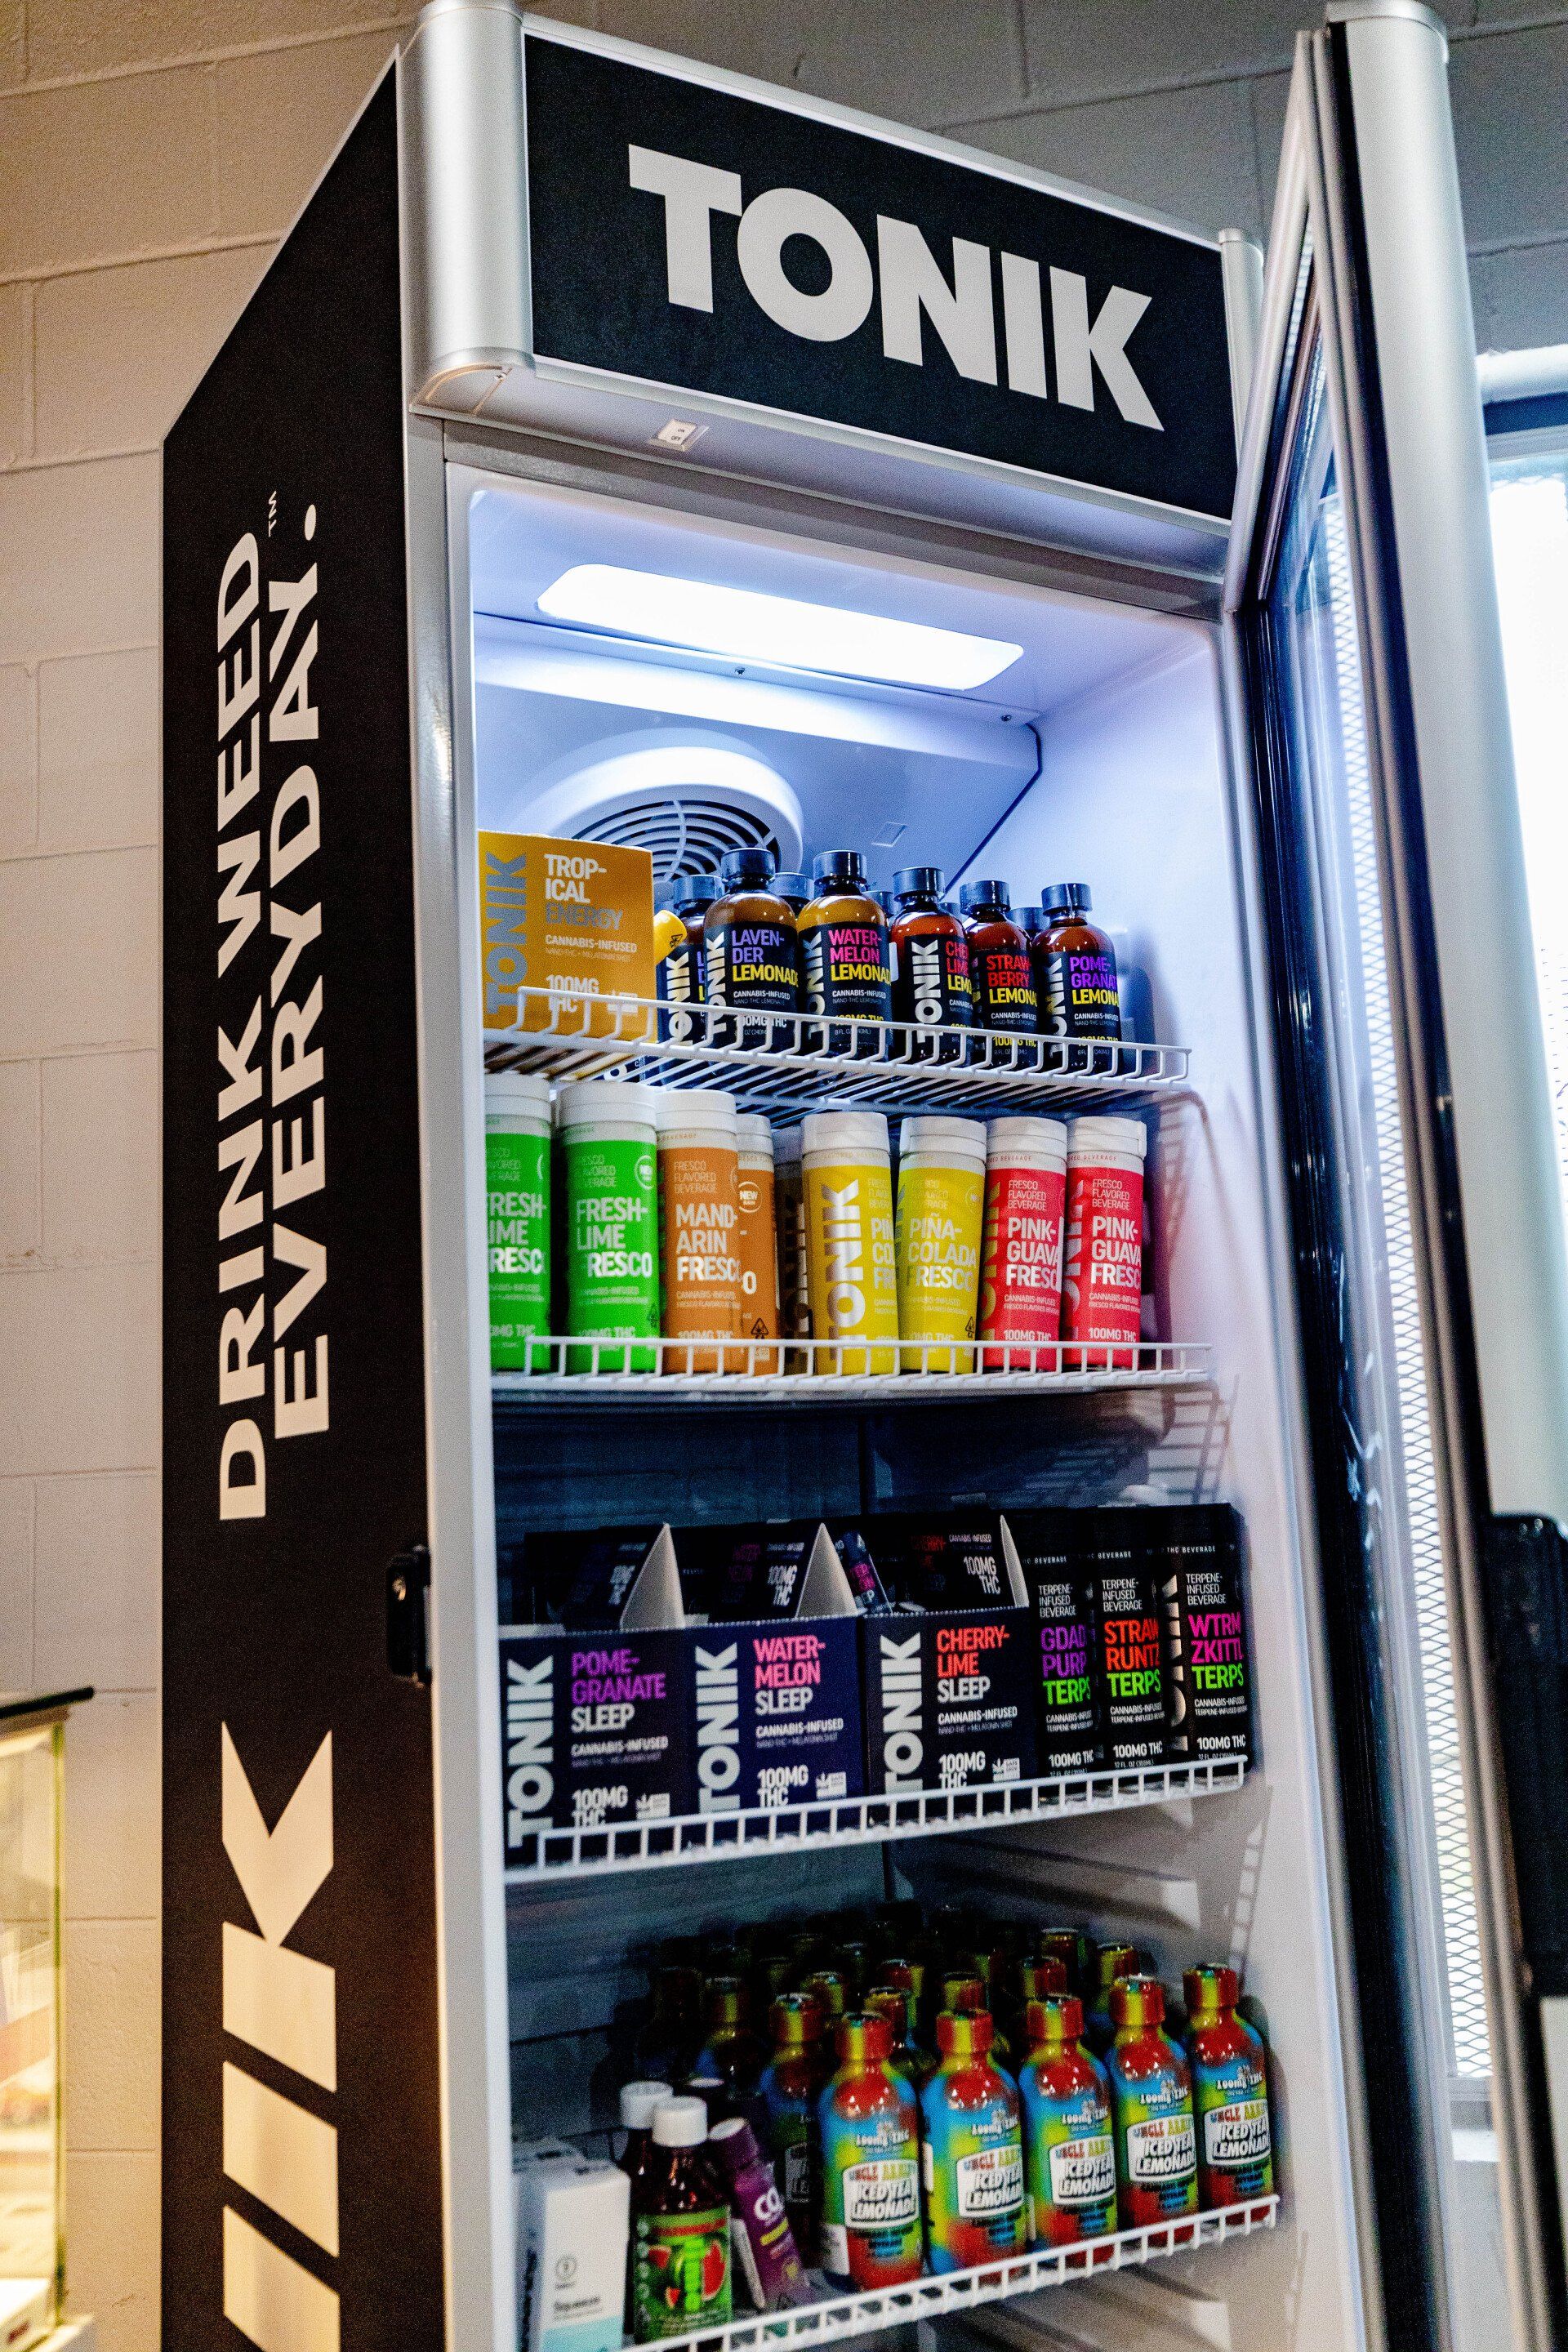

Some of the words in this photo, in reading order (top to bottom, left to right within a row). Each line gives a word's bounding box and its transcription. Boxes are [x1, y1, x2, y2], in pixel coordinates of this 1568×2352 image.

[629, 144, 1165, 431] TONIK
[218, 532, 261, 978] WEED
[544, 853, 607, 880] TROP-
[545, 878, 590, 903] ICAL
[546, 902, 623, 930] ENERGY
[486, 851, 528, 1014] TONIK
[545, 934, 637, 953] CANNABIS-INFUSED
[732, 929, 785, 947] LAVEN-
[827, 929, 882, 946] WATER-
[732, 947, 764, 964] DER
[830, 947, 880, 964] MELON
[1070, 956, 1111, 972] POME-
[269, 504, 329, 1439] EVERYDAY.
[987, 970, 1030, 987] BERRY
[733, 990, 791, 1000] CANNABIS-INFUSED
[832, 989, 887, 1000] CANNABIS-INFUSED
[911, 940, 942, 1044] TONIK
[739, 1190, 758, 1201] NEW
[1009, 1179, 1039, 1189] FRESCO
[1009, 1189, 1047, 1200] FLAVORED
[1092, 1188, 1130, 1200] FLAVORED
[1093, 1178, 1123, 1189] FRESCO
[487, 1192, 547, 1218] RESH-
[577, 1196, 648, 1223] FRESH-
[675, 1203, 738, 1228] MAND-
[1008, 1199, 1047, 1212] BEVERAGE
[1092, 1199, 1130, 1212] BEVERAGE
[488, 1219, 529, 1245] IME
[577, 1224, 626, 1250] LIME
[910, 1212, 962, 1241] PIÑA-
[1007, 1217, 1056, 1242] PINK-
[1092, 1216, 1138, 1241] PINK-
[676, 1229, 728, 1255] ARIN
[1006, 1240, 1059, 1266] GUAVA
[1091, 1239, 1141, 1267] GUAVA
[218, 996, 265, 1520] DRINK
[586, 1251, 653, 1279] RESCO
[908, 1241, 977, 1268] COLADA
[821, 1178, 866, 1360] TONIK
[1004, 1330, 1036, 1342] 100MG
[1088, 1328, 1121, 1340] 100MG
[1123, 1330, 1137, 1342] THC
[1097, 1550, 1132, 1559] BEVERAGE
[1182, 1545, 1216, 1553] BEVERAGE
[963, 1556, 997, 1576] 100MG
[1186, 1572, 1223, 1584] TERPENE-
[979, 1575, 1001, 1595] THC
[1038, 1583, 1073, 1596] TERPENE-
[1101, 1578, 1139, 1590] TERPENE-
[1102, 1589, 1136, 1601] INFUSED
[1187, 1583, 1220, 1594] INFUSED
[1039, 1594, 1071, 1606] INFUSED
[1103, 1599, 1143, 1613] BEVERAGE
[1187, 1593, 1226, 1606] BEVERAGE
[1039, 1605, 1076, 1619] BEVERAGE
[1188, 1611, 1241, 1637] WTRM
[753, 1634, 826, 1663] WATER-
[936, 1624, 1010, 1653] CHERRY-
[572, 1648, 640, 1677] POME-
[937, 1651, 980, 1679] LIME
[755, 1660, 821, 1690] MELON
[1107, 1668, 1161, 1698] TERPS
[1192, 1662, 1245, 1690] TERPS
[572, 1673, 667, 1705] GRANATE
[755, 1686, 813, 1716] SLEEP
[937, 1676, 991, 1703] SLEEP
[1042, 1676, 1091, 1706] TERPS
[572, 1703, 635, 1733] SLEEP
[880, 1633, 924, 1795] TONIK
[938, 1706, 1018, 1725] CANNABIS-INFUSED
[695, 1642, 741, 1814] TONIK
[755, 1717, 844, 1739] CANNABIS-INFUSED
[506, 1655, 554, 1849] TONIK
[572, 1735, 669, 1757] CANNABIS-INFUSED
[1113, 1744, 1147, 1758] 100MG
[1148, 1740, 1163, 1756] THC
[1196, 1735, 1231, 1750] 100MG
[1232, 1734, 1246, 1748] THC
[938, 1750, 986, 1774] 100MG
[1049, 1750, 1082, 1768] 100MG
[1083, 1749, 1094, 1764] THC
[757, 1765, 809, 1788] 100MG
[939, 1771, 968, 1789] THC
[572, 1785, 628, 1811] 100MG
[757, 1786, 789, 1808] THC
[572, 1808, 606, 1829] THC
[1220, 2123, 1250, 2142] ICED
[1251, 2118, 1267, 2139] TEA
[1144, 2137, 1174, 2158] ICED
[1175, 2132, 1192, 2154] TEA
[976, 2169, 1005, 2193] ICED
[1065, 2159, 1094, 2180] ICED
[859, 2180, 889, 2204] ICED
